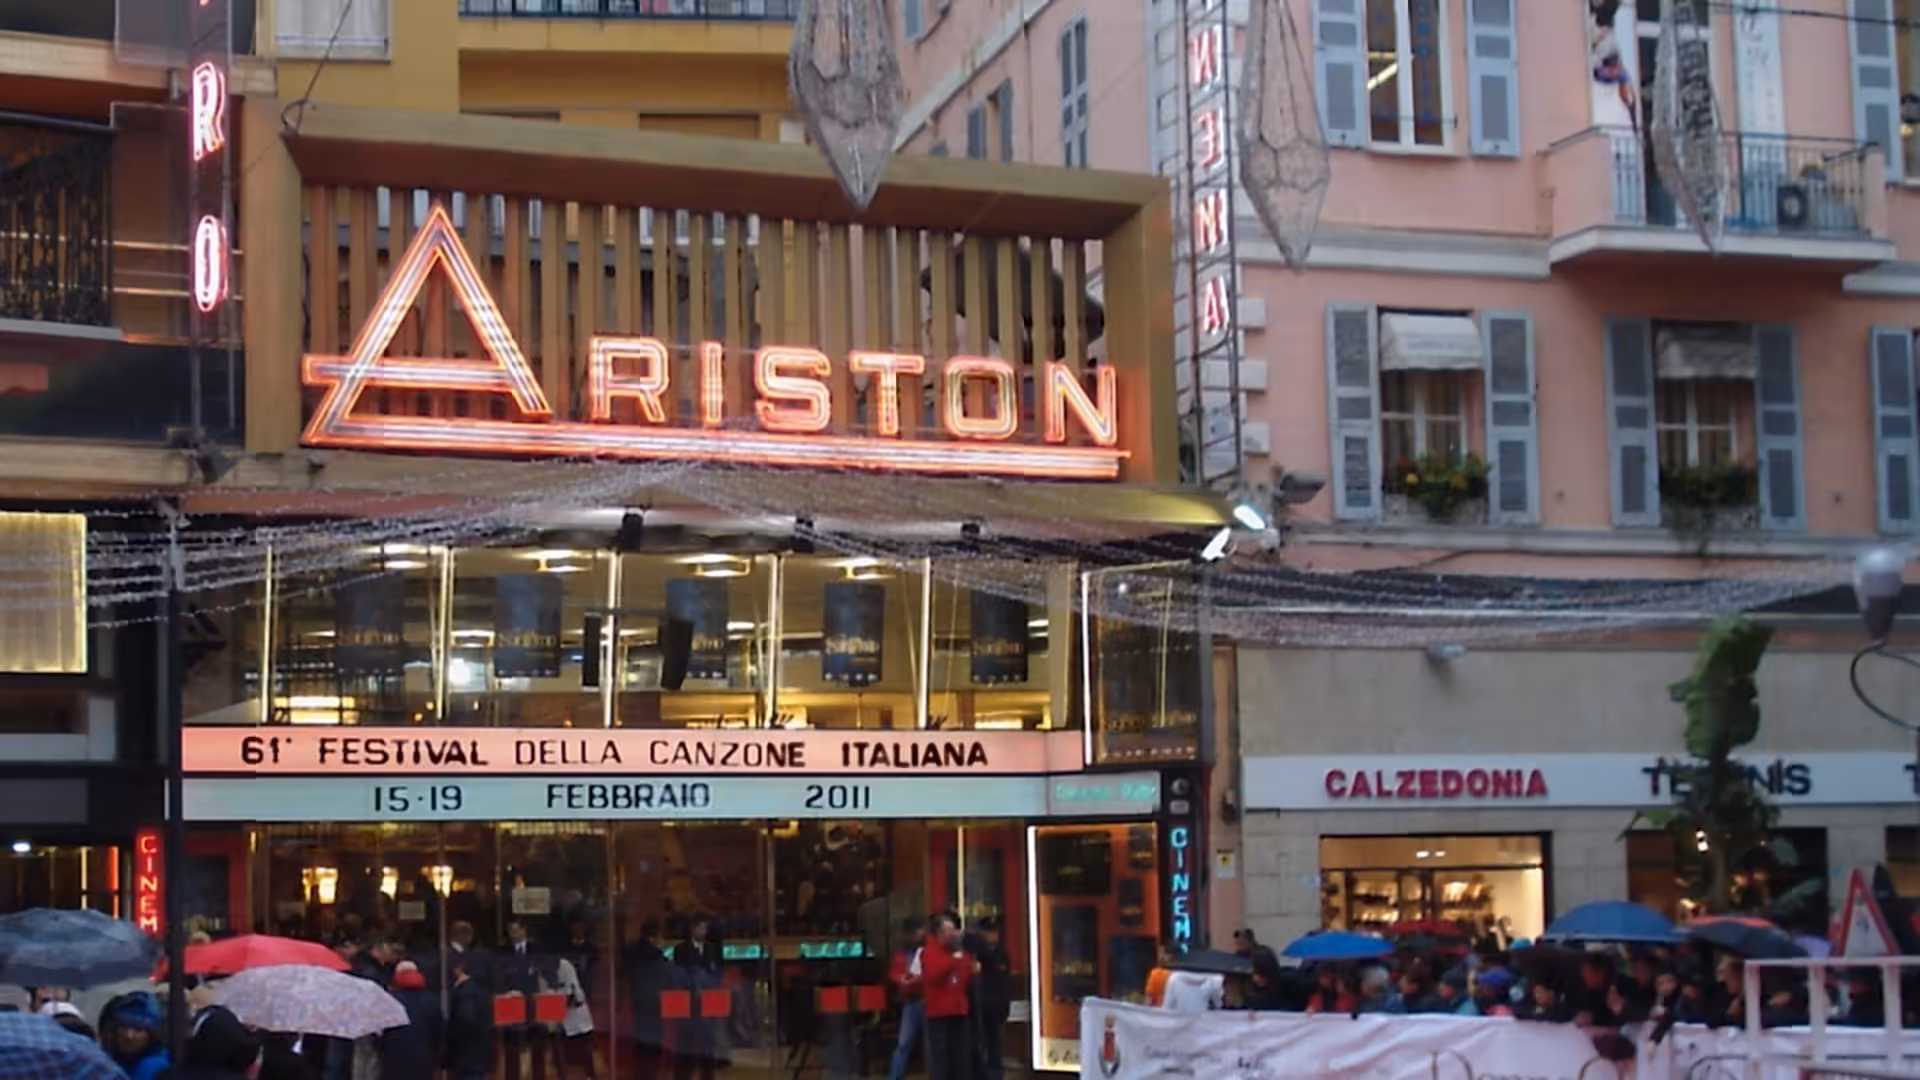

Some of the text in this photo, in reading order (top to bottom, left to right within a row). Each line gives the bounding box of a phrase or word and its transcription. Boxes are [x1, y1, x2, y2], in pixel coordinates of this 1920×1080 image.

[192, 0, 228, 313] RO
[302, 205, 1122, 450] ARISTON
[319, 738, 489, 766] FESTIVAL
[515, 740, 622, 765] DELLA
[650, 740, 805, 767] CANZONE
[842, 742, 989, 768] ITALIANA
[547, 783, 710, 809] FEBBRAIO
[805, 785, 870, 809] 2011
[1325, 769, 1548, 798] CALZEDONIA
[1642, 762, 1812, 796] TENIS
[140, 836, 158, 933] CINEM
